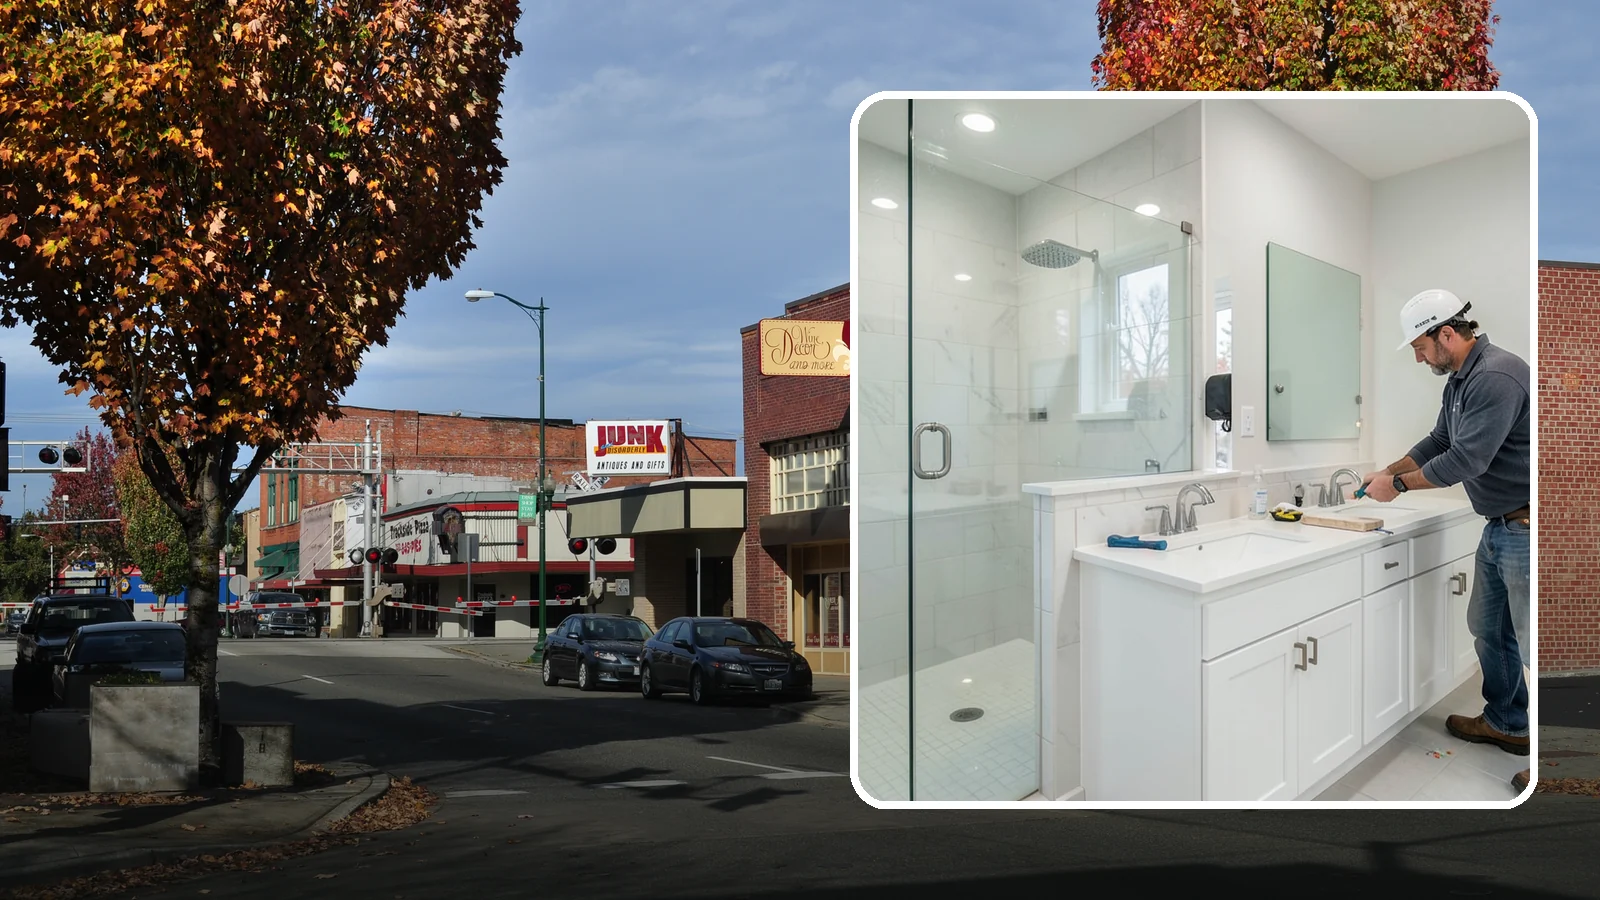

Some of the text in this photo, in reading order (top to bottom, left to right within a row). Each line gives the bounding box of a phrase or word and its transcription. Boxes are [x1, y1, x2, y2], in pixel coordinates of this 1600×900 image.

[595, 425, 665, 457] JUNK
[607, 446, 646, 454] DISORDERLY
[596, 460, 665, 470] ANTIQUES AND GIFTS
[352, 498, 365, 511] CRO
[414, 520, 429, 534] Pizza
